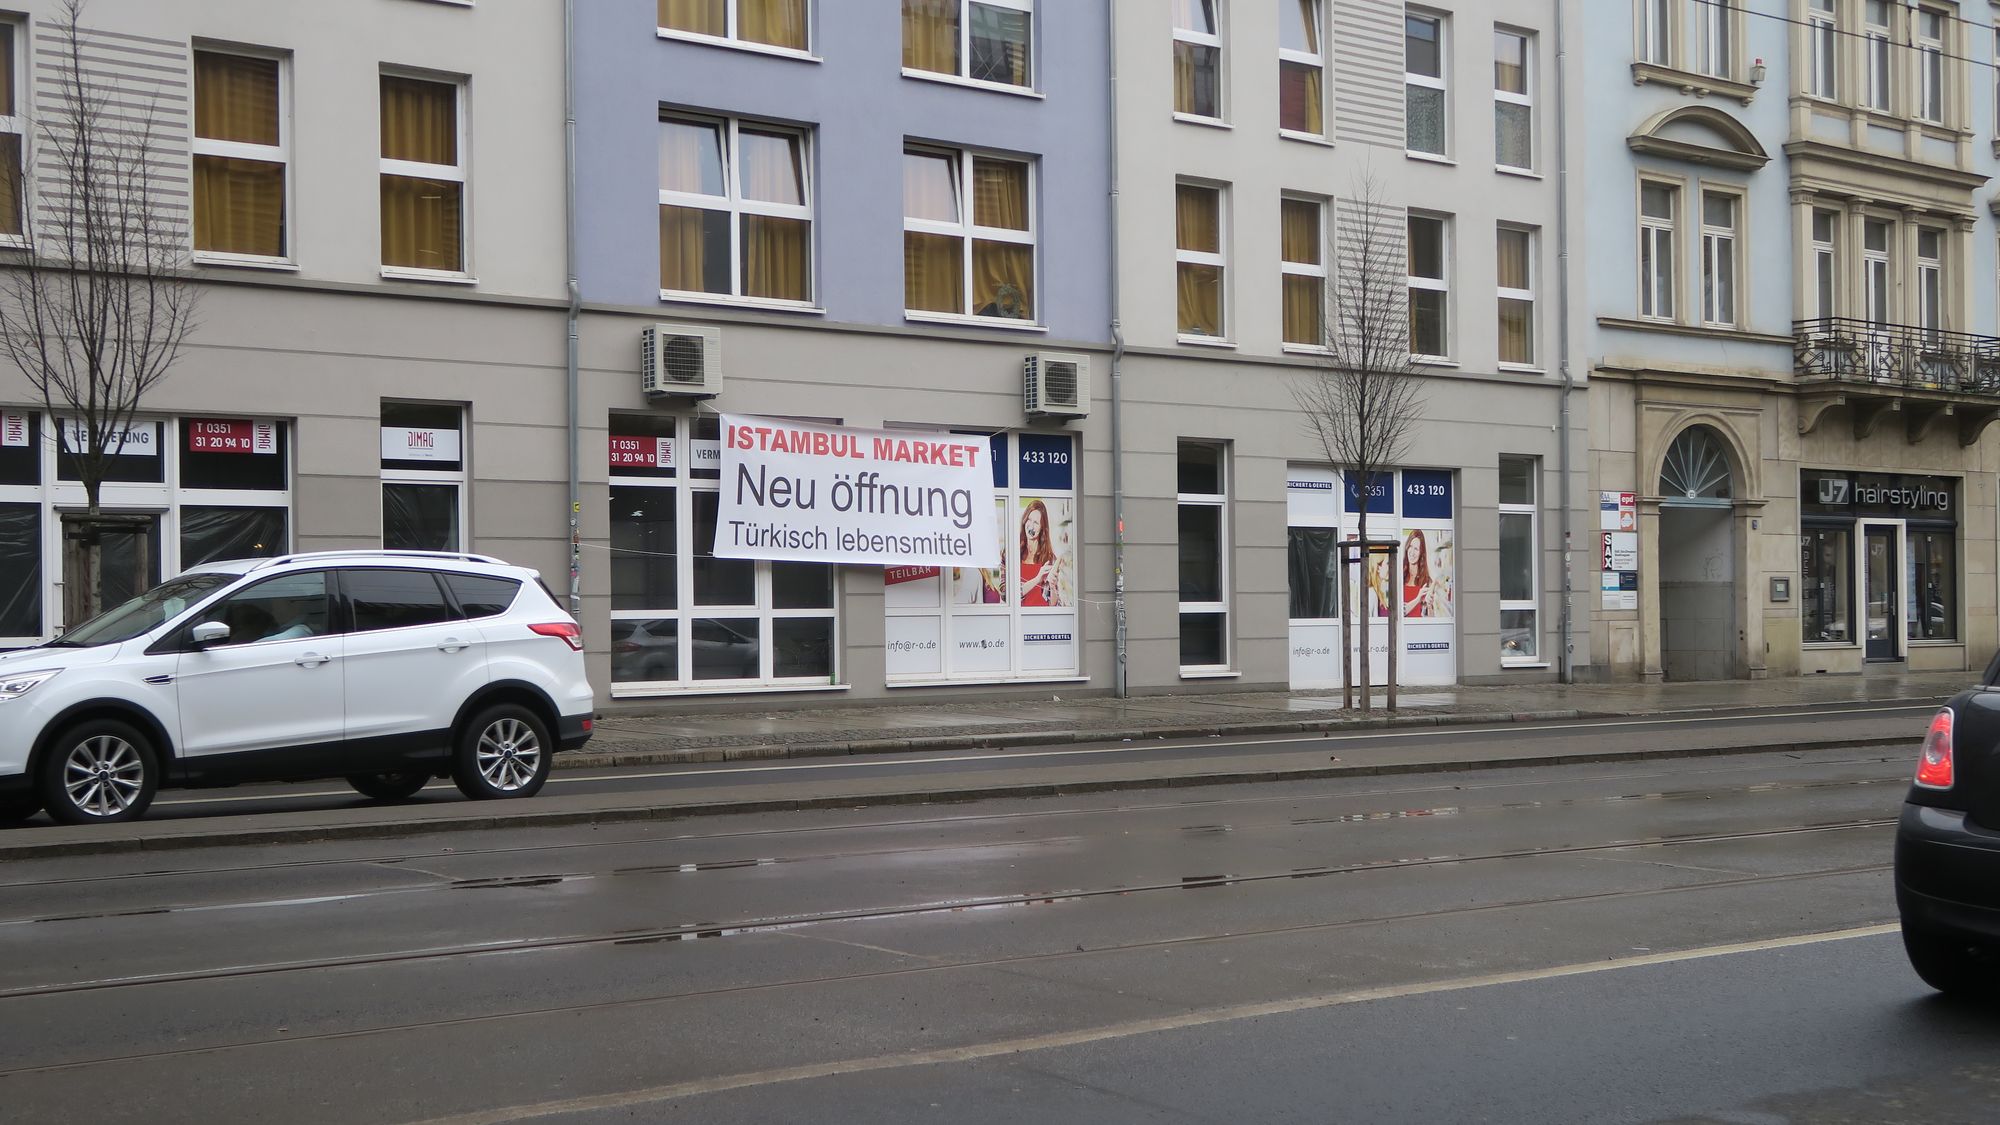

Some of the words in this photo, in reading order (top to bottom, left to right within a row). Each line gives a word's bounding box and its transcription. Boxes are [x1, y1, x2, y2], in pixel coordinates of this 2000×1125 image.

[196, 423, 203, 433] T
[206, 423, 231, 433] 0351
[72, 430, 149, 443] VEETUNG
[195, 436, 206, 447] 31
[210, 437, 223, 448] 20
[225, 438, 237, 448] 94
[240, 438, 250, 448] 10
[612, 440, 617, 449] T
[620, 440, 639, 450] 0351
[727, 425, 865, 459] ISTAMBUL
[873, 437, 980, 467] MARKET
[611, 453, 620, 462] 31
[623, 453, 633, 462] 20
[634, 454, 644, 463] 94
[646, 454, 655, 463] 10
[696, 449, 720, 460] VERM
[1022, 451, 1045, 463] 433
[1048, 452, 1068, 464] 120
[736, 463, 816, 510] Neu
[831, 471, 973, 529] öffnung
[1406, 484, 1425, 495] 433
[1428, 485, 1445, 496] 120
[1855, 482, 1948, 510] hairstyling
[1621, 495, 1634, 504] epd
[728, 520, 828, 550] Türkisch
[836, 526, 973, 556] lebensmittel
[1604, 534, 1612, 568] SAX
[887, 640, 937, 651] info@r-o.de
[959, 639, 1004, 649] www.o.de
[1292, 647, 1330, 657] info@r-o.de
